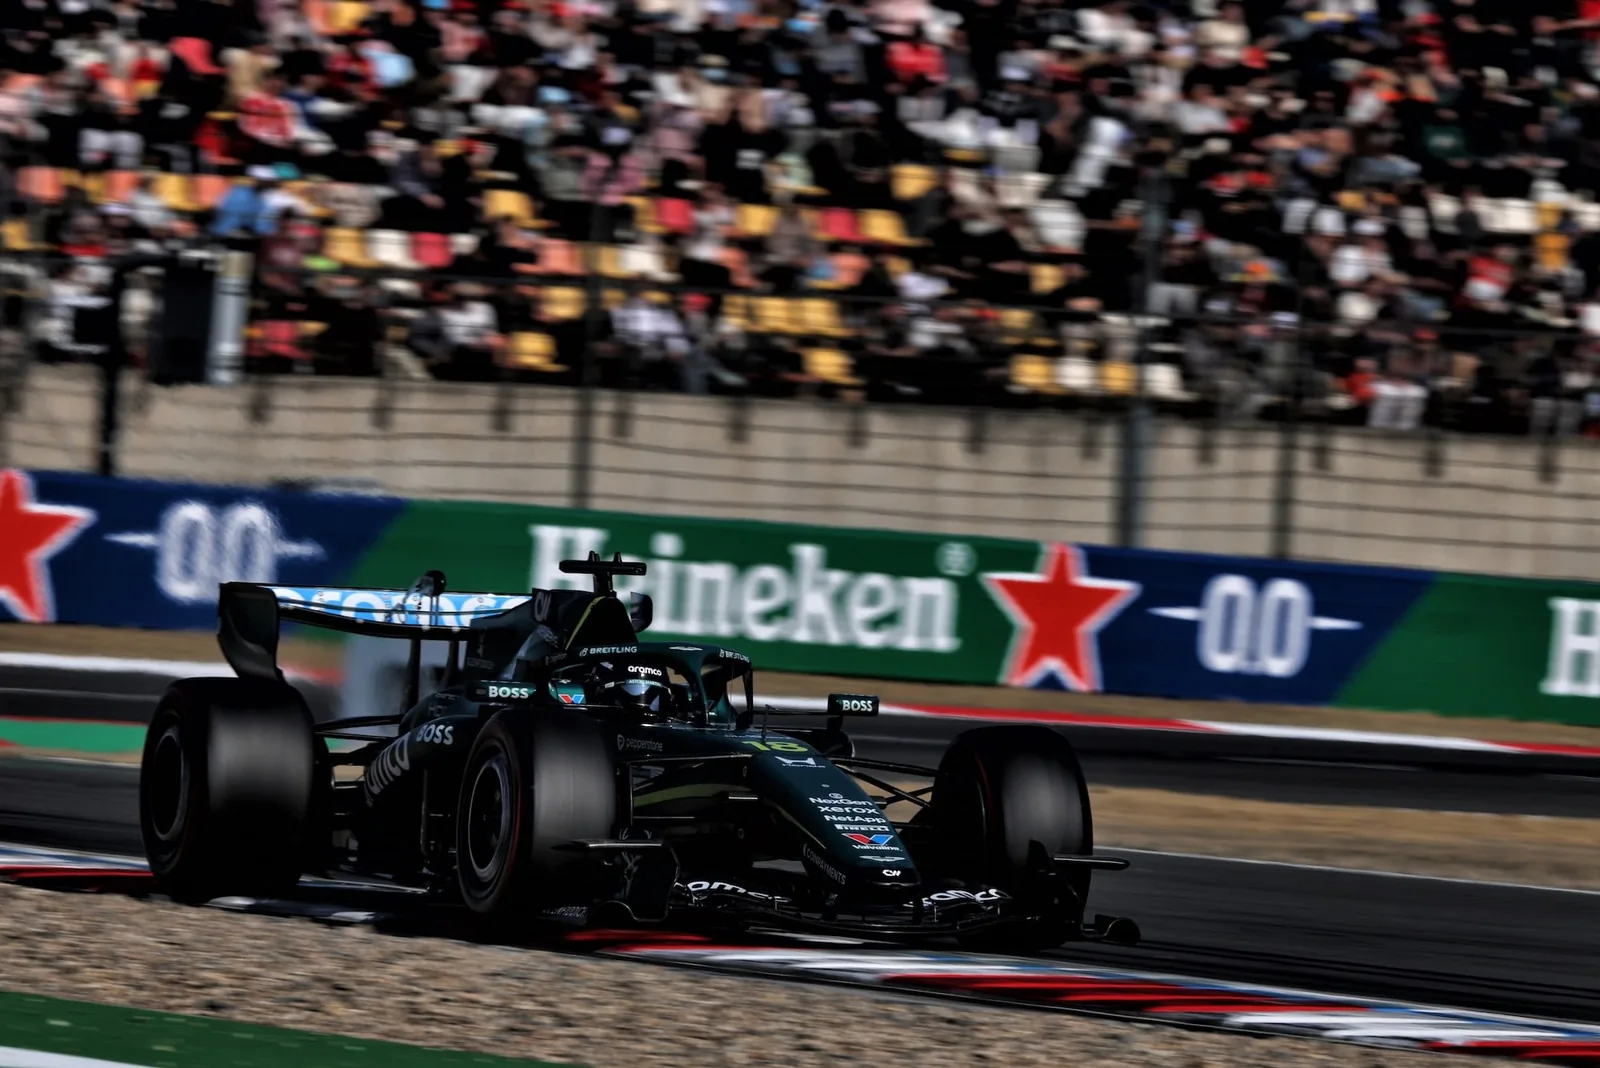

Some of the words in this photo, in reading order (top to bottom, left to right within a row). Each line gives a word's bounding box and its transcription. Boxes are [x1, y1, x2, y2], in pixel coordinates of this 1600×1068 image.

[589, 645, 638, 655] BREITLING
[627, 665, 662, 676] aramco
[488, 685, 529, 700] BOSS
[842, 699, 873, 712] BOSS
[415, 723, 454, 745] BOSS
[741, 740, 809, 752] 18
[808, 797, 873, 806] NexGen
[817, 805, 880, 815] xerox
[823, 814, 887, 824] NetApp
[852, 844, 903, 852] Valvoline
